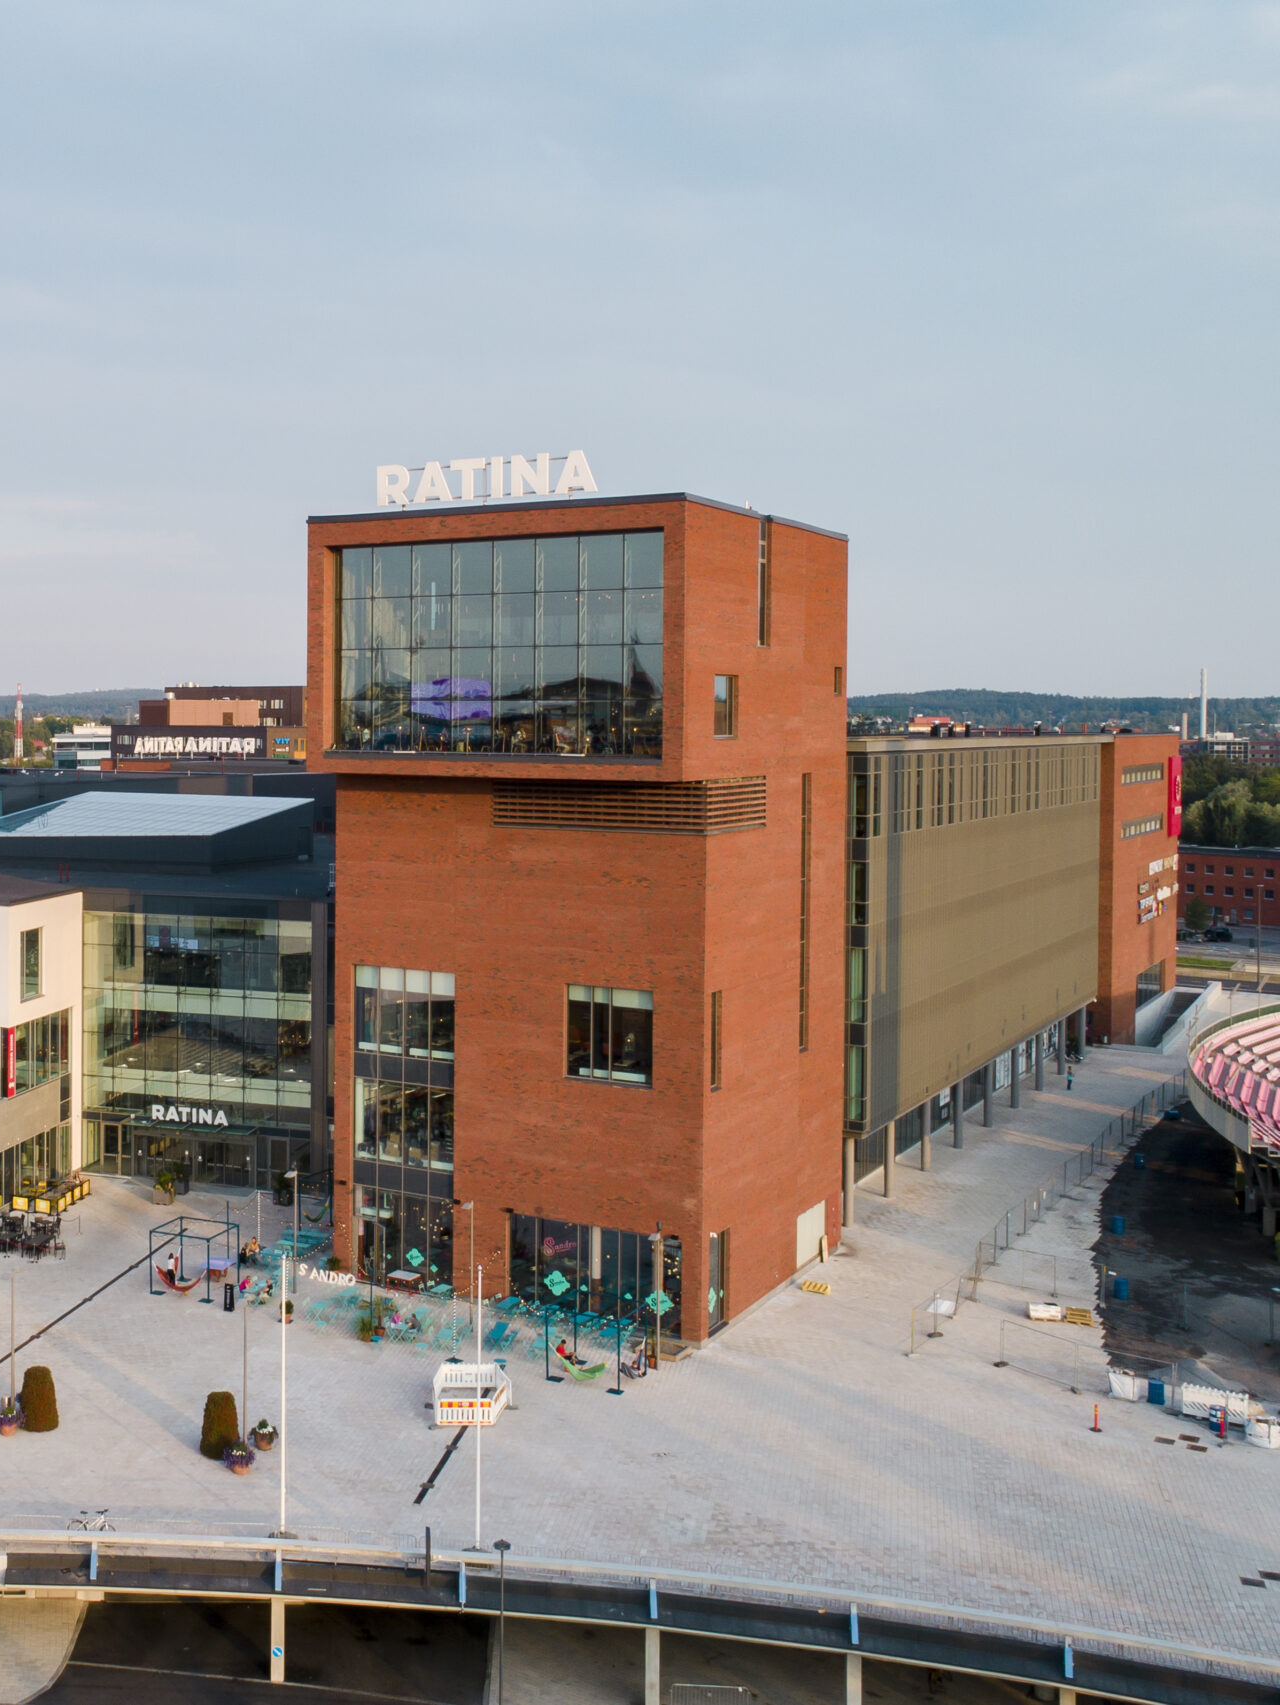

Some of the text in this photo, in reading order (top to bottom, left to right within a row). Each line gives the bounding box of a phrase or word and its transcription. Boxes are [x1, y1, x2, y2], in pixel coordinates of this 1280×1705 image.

[376, 450, 598, 506] RATINA
[151, 1104, 228, 1126] RATINA
[544, 1237, 577, 1256] Sandro
[299, 1263, 355, 1286] SANDRO
